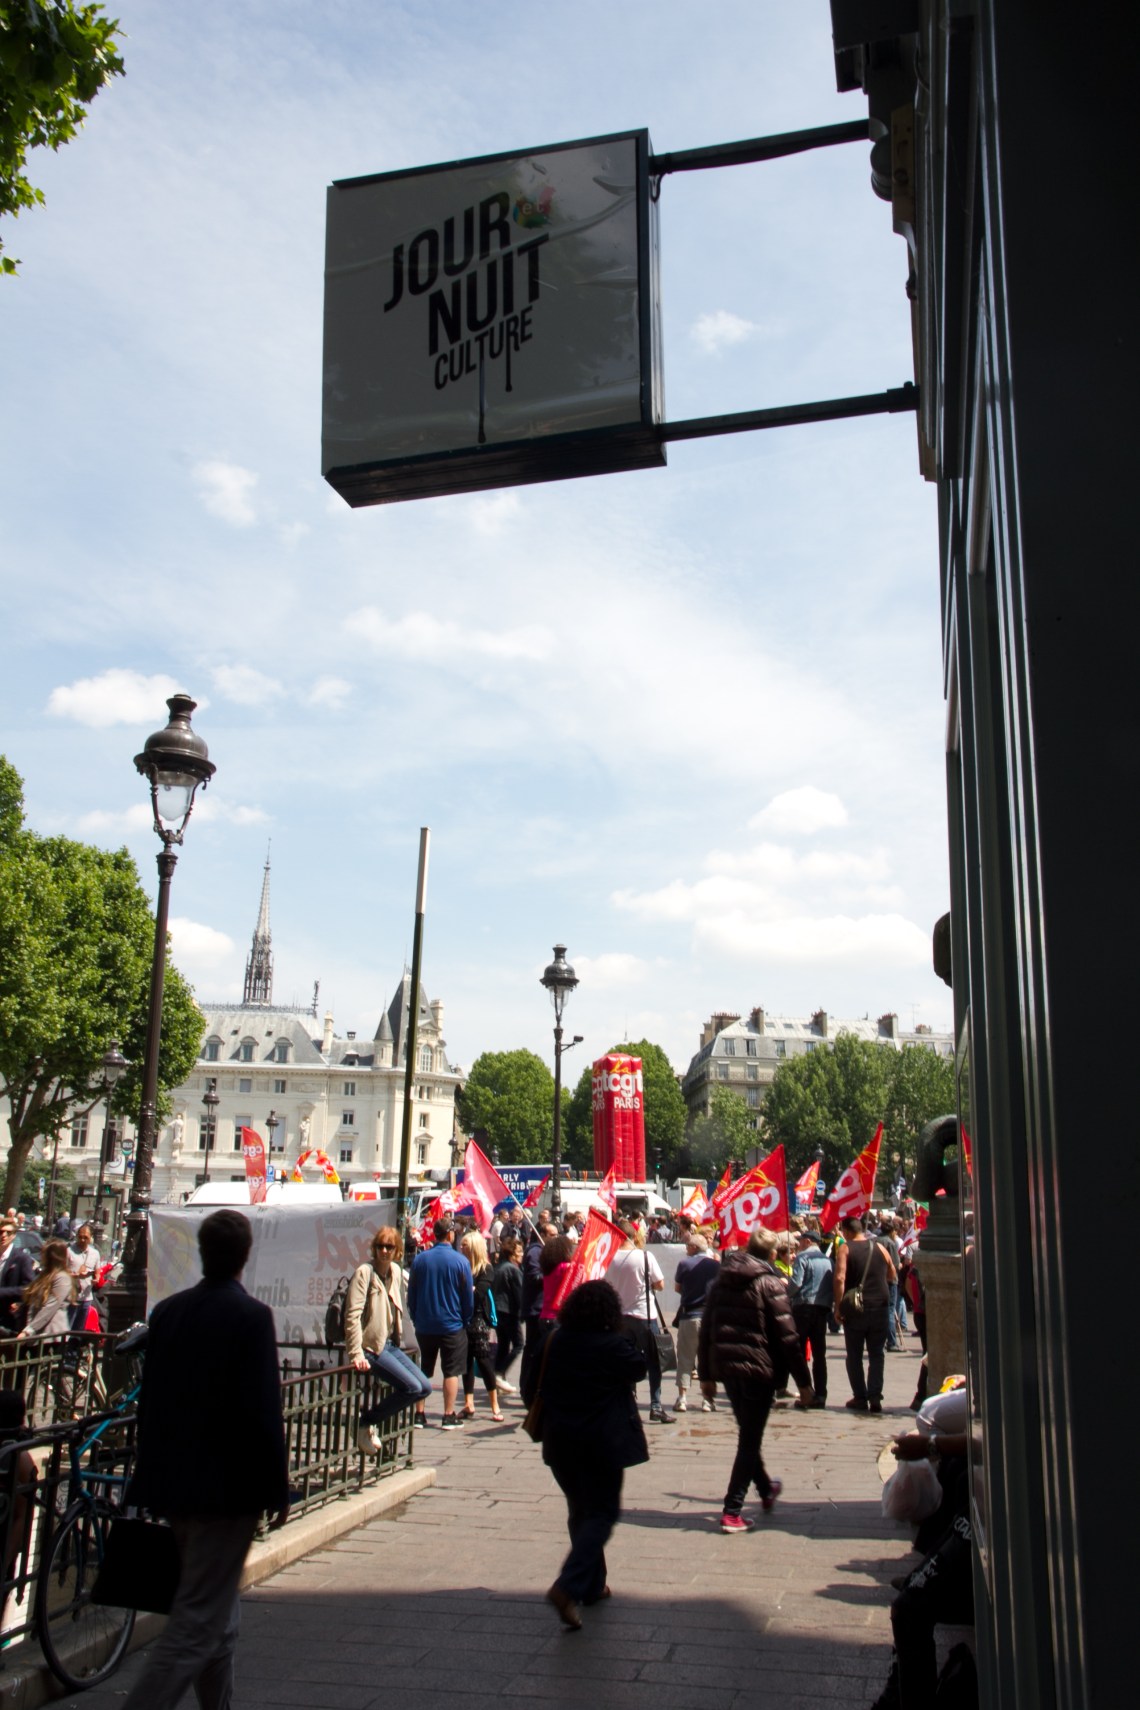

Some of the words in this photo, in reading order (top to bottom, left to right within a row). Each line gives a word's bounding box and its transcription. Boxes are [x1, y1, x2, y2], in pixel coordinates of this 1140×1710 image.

[384, 191, 511, 312] JOUR
[522, 200, 546, 216] et
[428, 233, 550, 357] NUIT
[433, 305, 533, 392] CULTURE
[608, 1069, 643, 1098] cgt
[614, 1097, 640, 1109] PARIS
[499, 1173, 519, 1182] ARLY
[506, 1181, 530, 1190] TRIB
